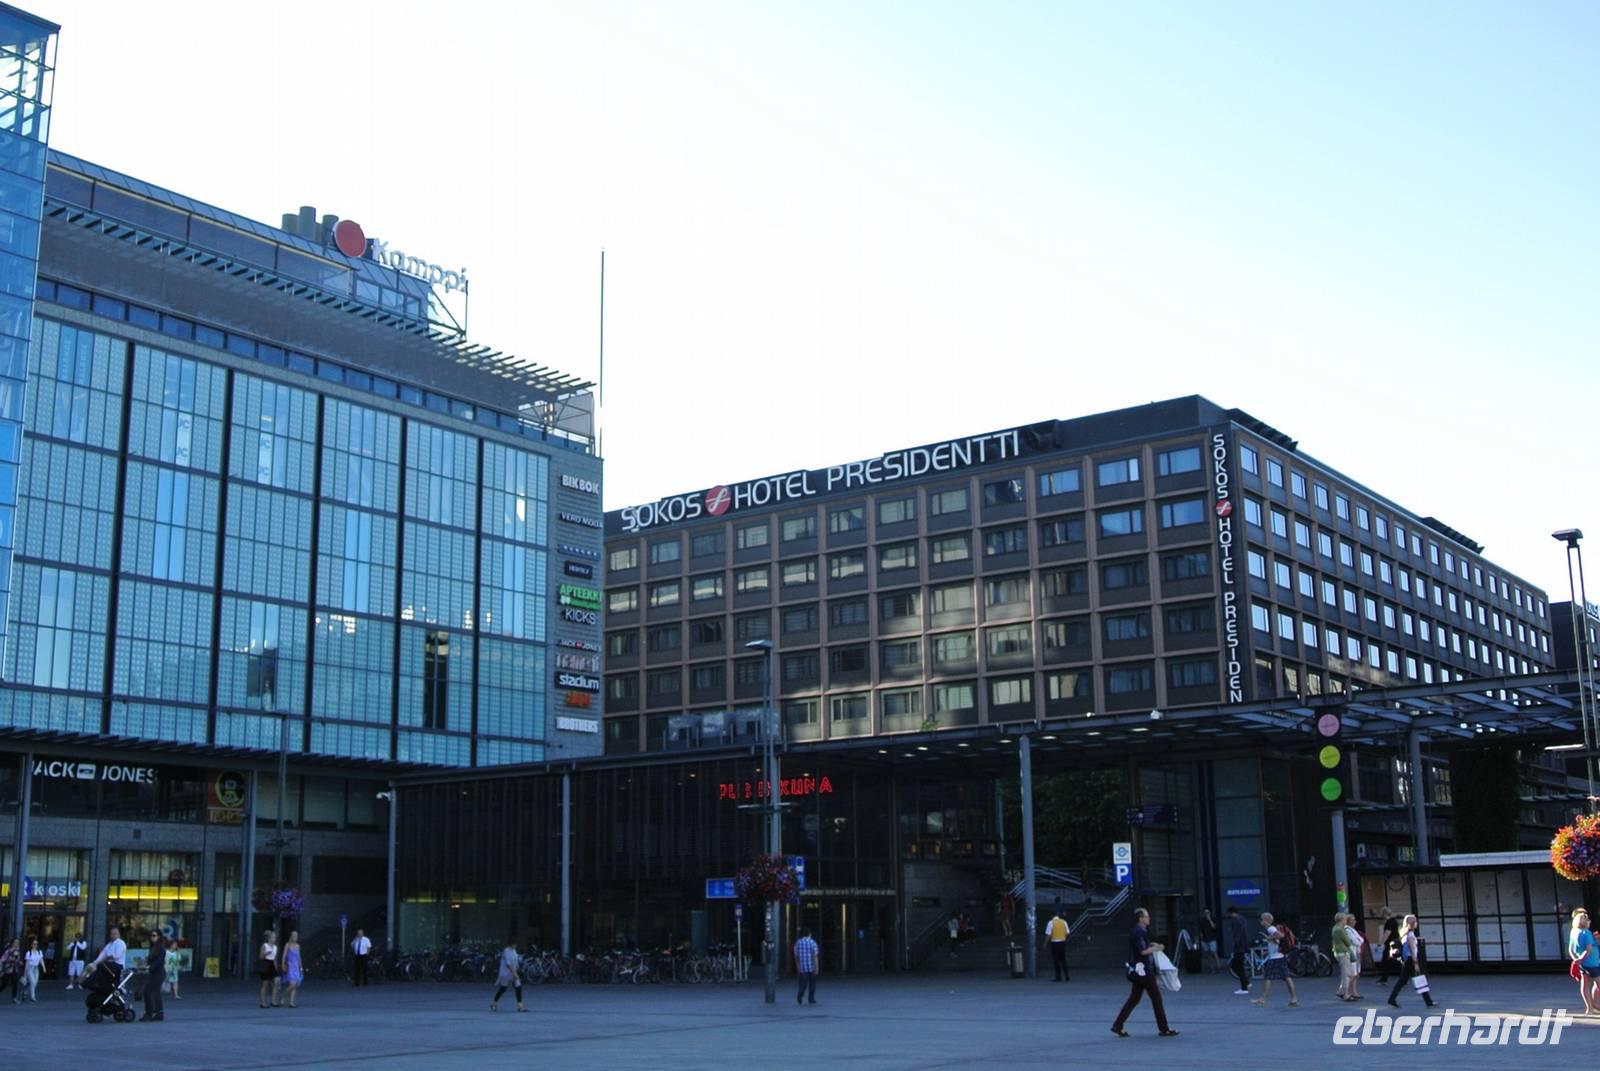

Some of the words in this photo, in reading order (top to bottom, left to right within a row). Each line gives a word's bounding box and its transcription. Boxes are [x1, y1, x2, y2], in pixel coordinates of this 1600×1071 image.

[372, 238, 466, 293] Kamppi
[621, 493, 701, 532] SOKOS
[734, 472, 816, 510] HOTEL
[827, 430, 1019, 491] PRESIDENTTI
[1213, 433, 1229, 499] SOKOS
[1219, 517, 1234, 584] HOTEL
[564, 608, 596, 625] KICKS
[1223, 591, 1243, 703] PRESIDEN
[559, 673, 599, 691] stadium
[101, 764, 159, 784] JONES
[34, 880, 81, 897] koski
[1117, 865, 1129, 883] P
